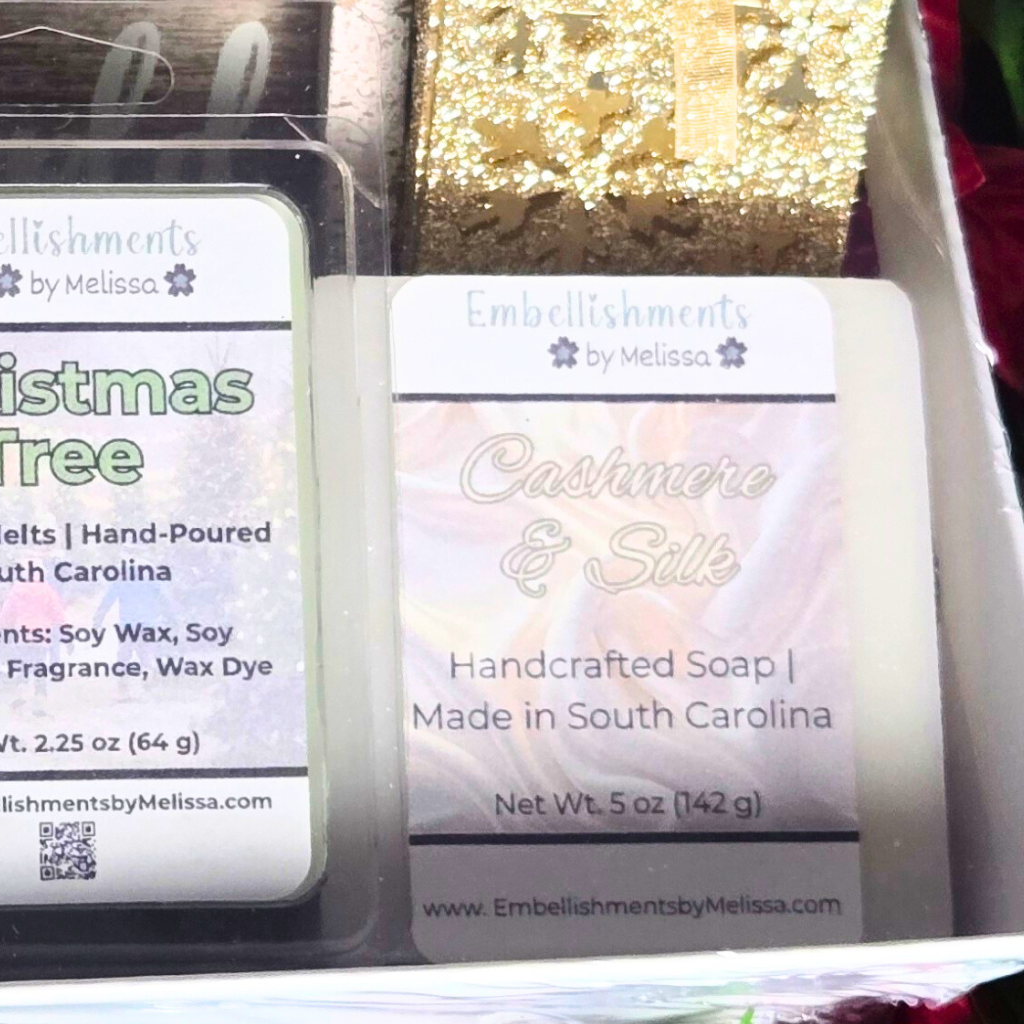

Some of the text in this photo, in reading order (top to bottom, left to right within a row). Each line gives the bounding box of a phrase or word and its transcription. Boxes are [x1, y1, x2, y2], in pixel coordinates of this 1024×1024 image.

[30, 270, 159, 302] by Melissa
[466, 290, 752, 330] Embellishments
[586, 343, 712, 374] by Melissa
[460, 432, 778, 505] Cashmere
[81, 522, 272, 545] Hand-Poured
[54, 559, 172, 582] Carolina
[500, 517, 741, 598] & Silk
[59, 624, 106, 647] Soy
[114, 623, 178, 646] Wax,
[186, 623, 233, 647] Soy
[7, 659, 148, 682] Fragrance,
[157, 658, 214, 677] Wax
[222, 657, 273, 680] Dye
[450, 649, 675, 680] Handcrafted
[686, 651, 775, 684] Soap
[413, 699, 833, 731] Made in South Carolina
[34, 734, 84, 753] 2.25
[91, 736, 121, 752] oz
[128, 732, 169, 755] (64
[175, 732, 200, 755] g)
[495, 791, 762, 819] Net Wt. 5 oz (142 g)
[423, 894, 841, 919] www. EmbellishmentsbyMelissa.com
